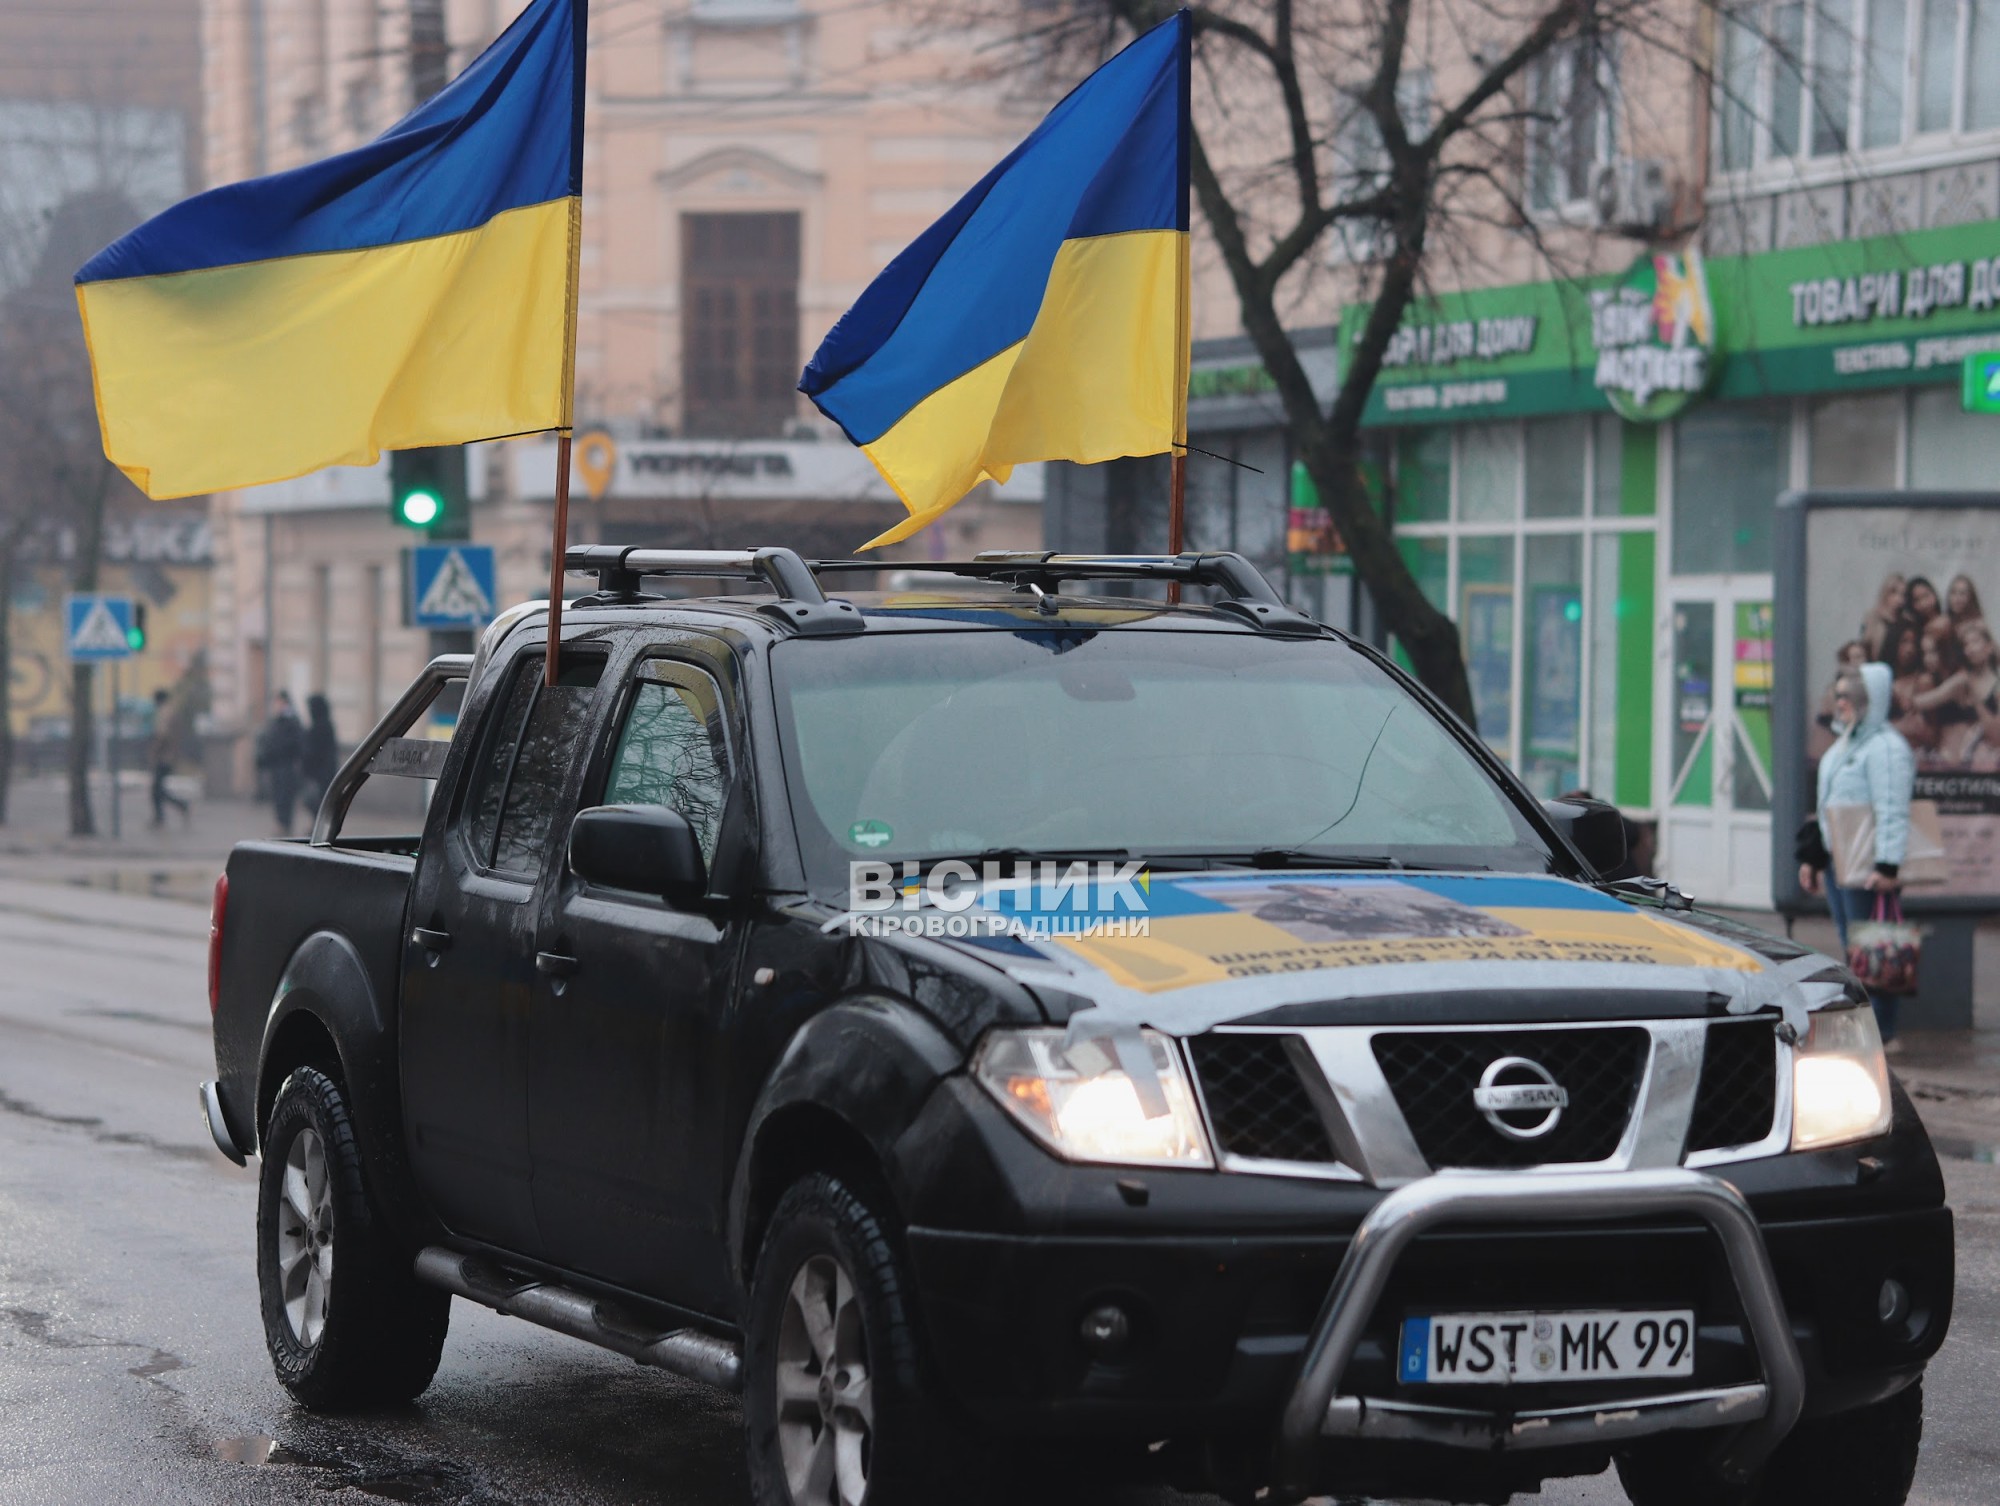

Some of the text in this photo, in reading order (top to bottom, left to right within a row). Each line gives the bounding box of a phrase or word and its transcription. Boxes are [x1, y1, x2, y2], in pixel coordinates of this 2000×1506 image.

[1790, 269, 1900, 327] ТОВАРИ
[1903, 260, 1965, 318] ДЛЯ
[1209, 943, 1373, 965] Шматько
[1488, 1089, 1561, 1104] NISSAN
[1435, 1324, 1528, 1374] WST
[1560, 1320, 1620, 1371] MK
[1634, 1318, 1689, 1368] 99
